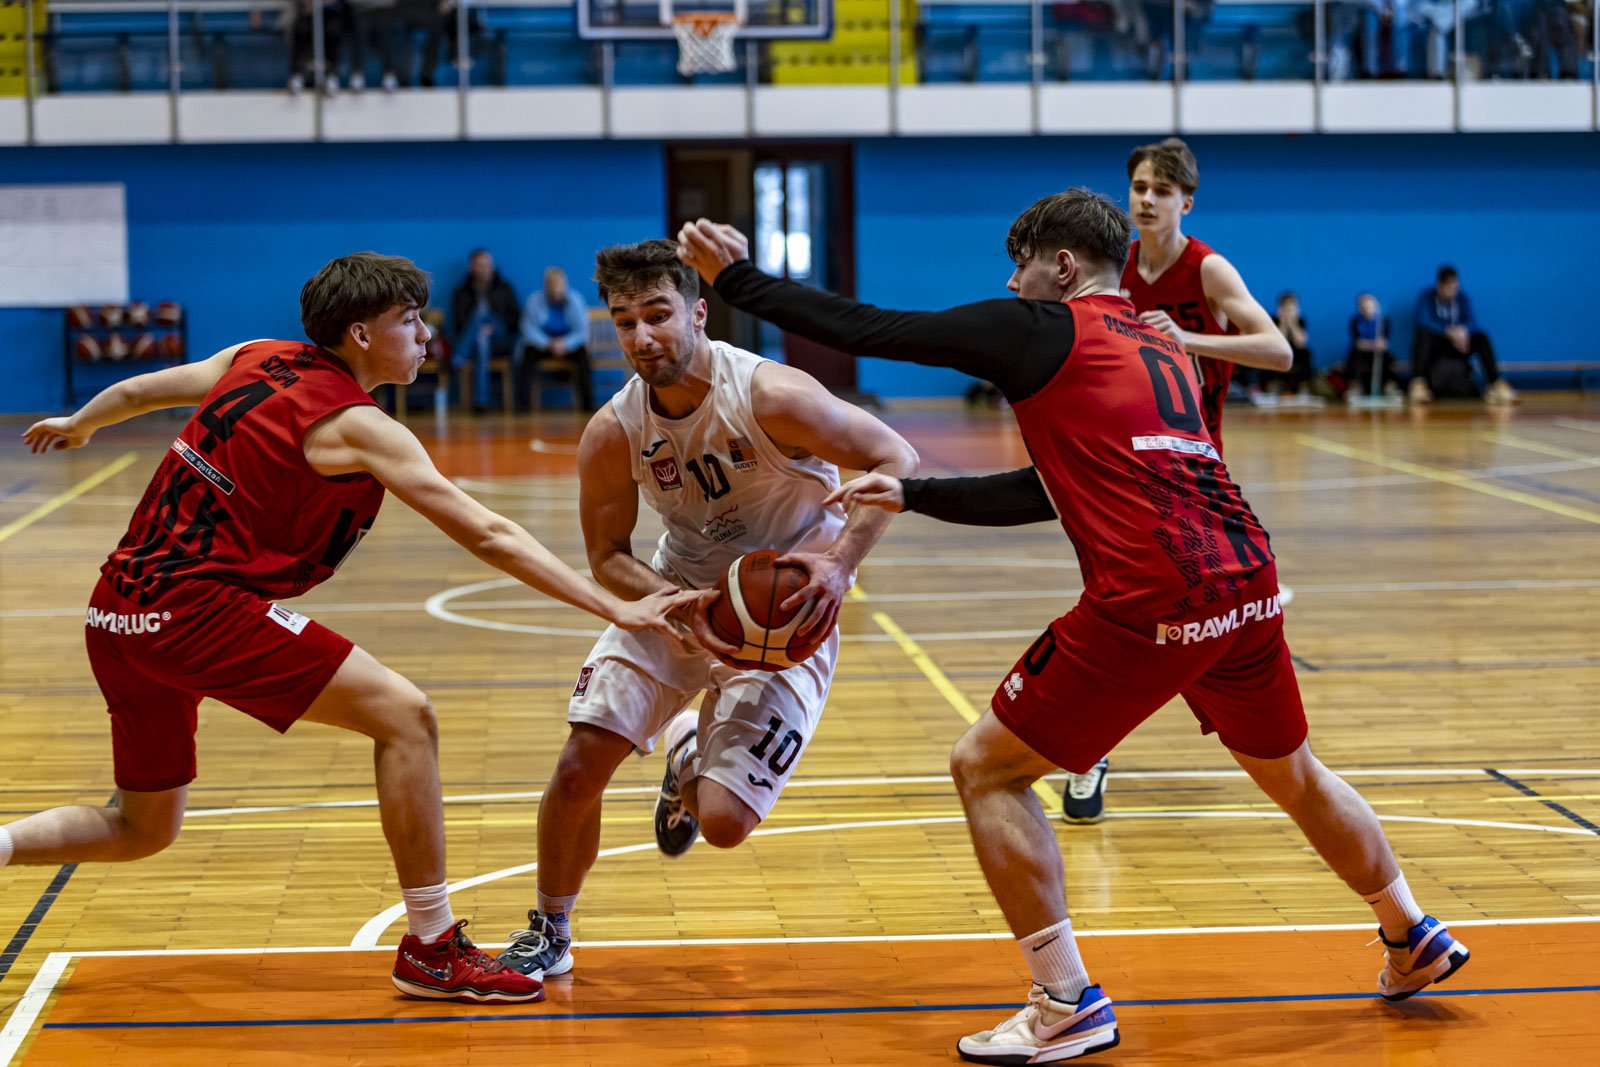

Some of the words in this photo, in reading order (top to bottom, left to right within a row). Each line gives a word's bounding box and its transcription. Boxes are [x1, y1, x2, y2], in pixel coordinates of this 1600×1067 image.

[1156, 301, 1206, 332] 5
[1138, 346, 1203, 433] 0
[197, 379, 278, 455] 4
[685, 453, 732, 502] 10
[733, 460, 758, 470] SUDETY
[1023, 622, 1056, 676] 0
[748, 716, 803, 776] 10
